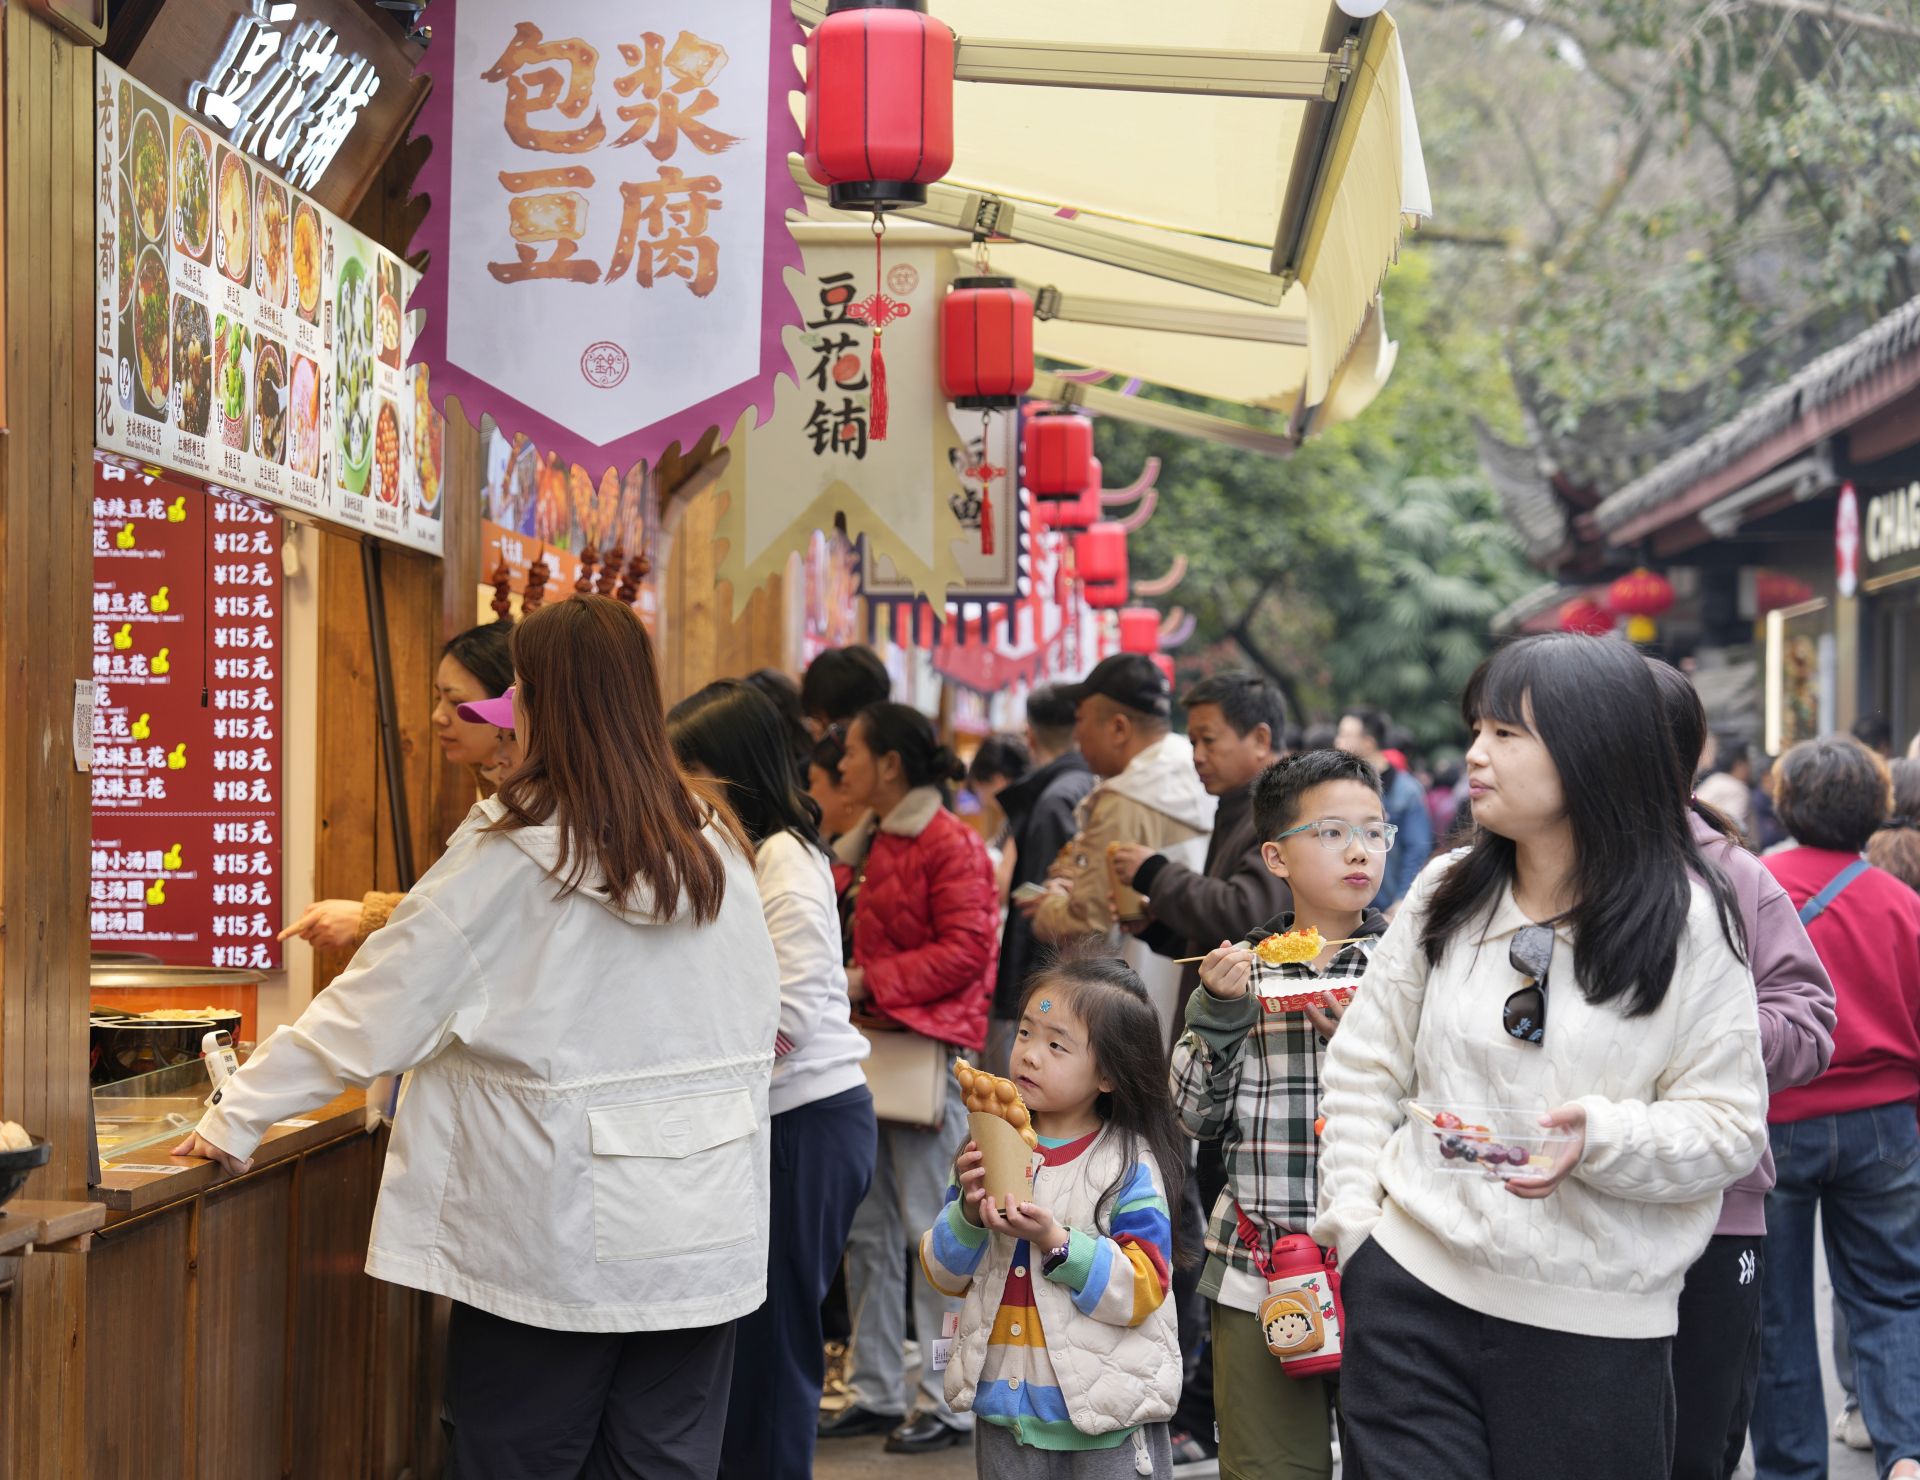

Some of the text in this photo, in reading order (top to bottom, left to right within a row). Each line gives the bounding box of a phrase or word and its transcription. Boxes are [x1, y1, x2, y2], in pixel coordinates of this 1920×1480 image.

[480, 21, 749, 162] 包浆
[487, 165, 723, 299] 豆腐
[97, 69, 116, 437] 老成都豆花
[803, 272, 869, 460] 豆花铺
[214, 531, 273, 554] ¥12元
[214, 563, 273, 586] ¥12元
[215, 594, 273, 618] ¥15元
[215, 625, 273, 649] ¥15元
[215, 656, 273, 679] ¥15元
[215, 687, 273, 710] ¥15元
[214, 716, 273, 739] ¥15元
[214, 748, 271, 771] ¥18元
[213, 779, 271, 802] ¥18元
[213, 820, 272, 844] ¥15元
[213, 851, 272, 875] ¥15元
[213, 881, 271, 905] ¥18元
[213, 913, 272, 937] ¥15元
[212, 944, 271, 968] ¥15元
